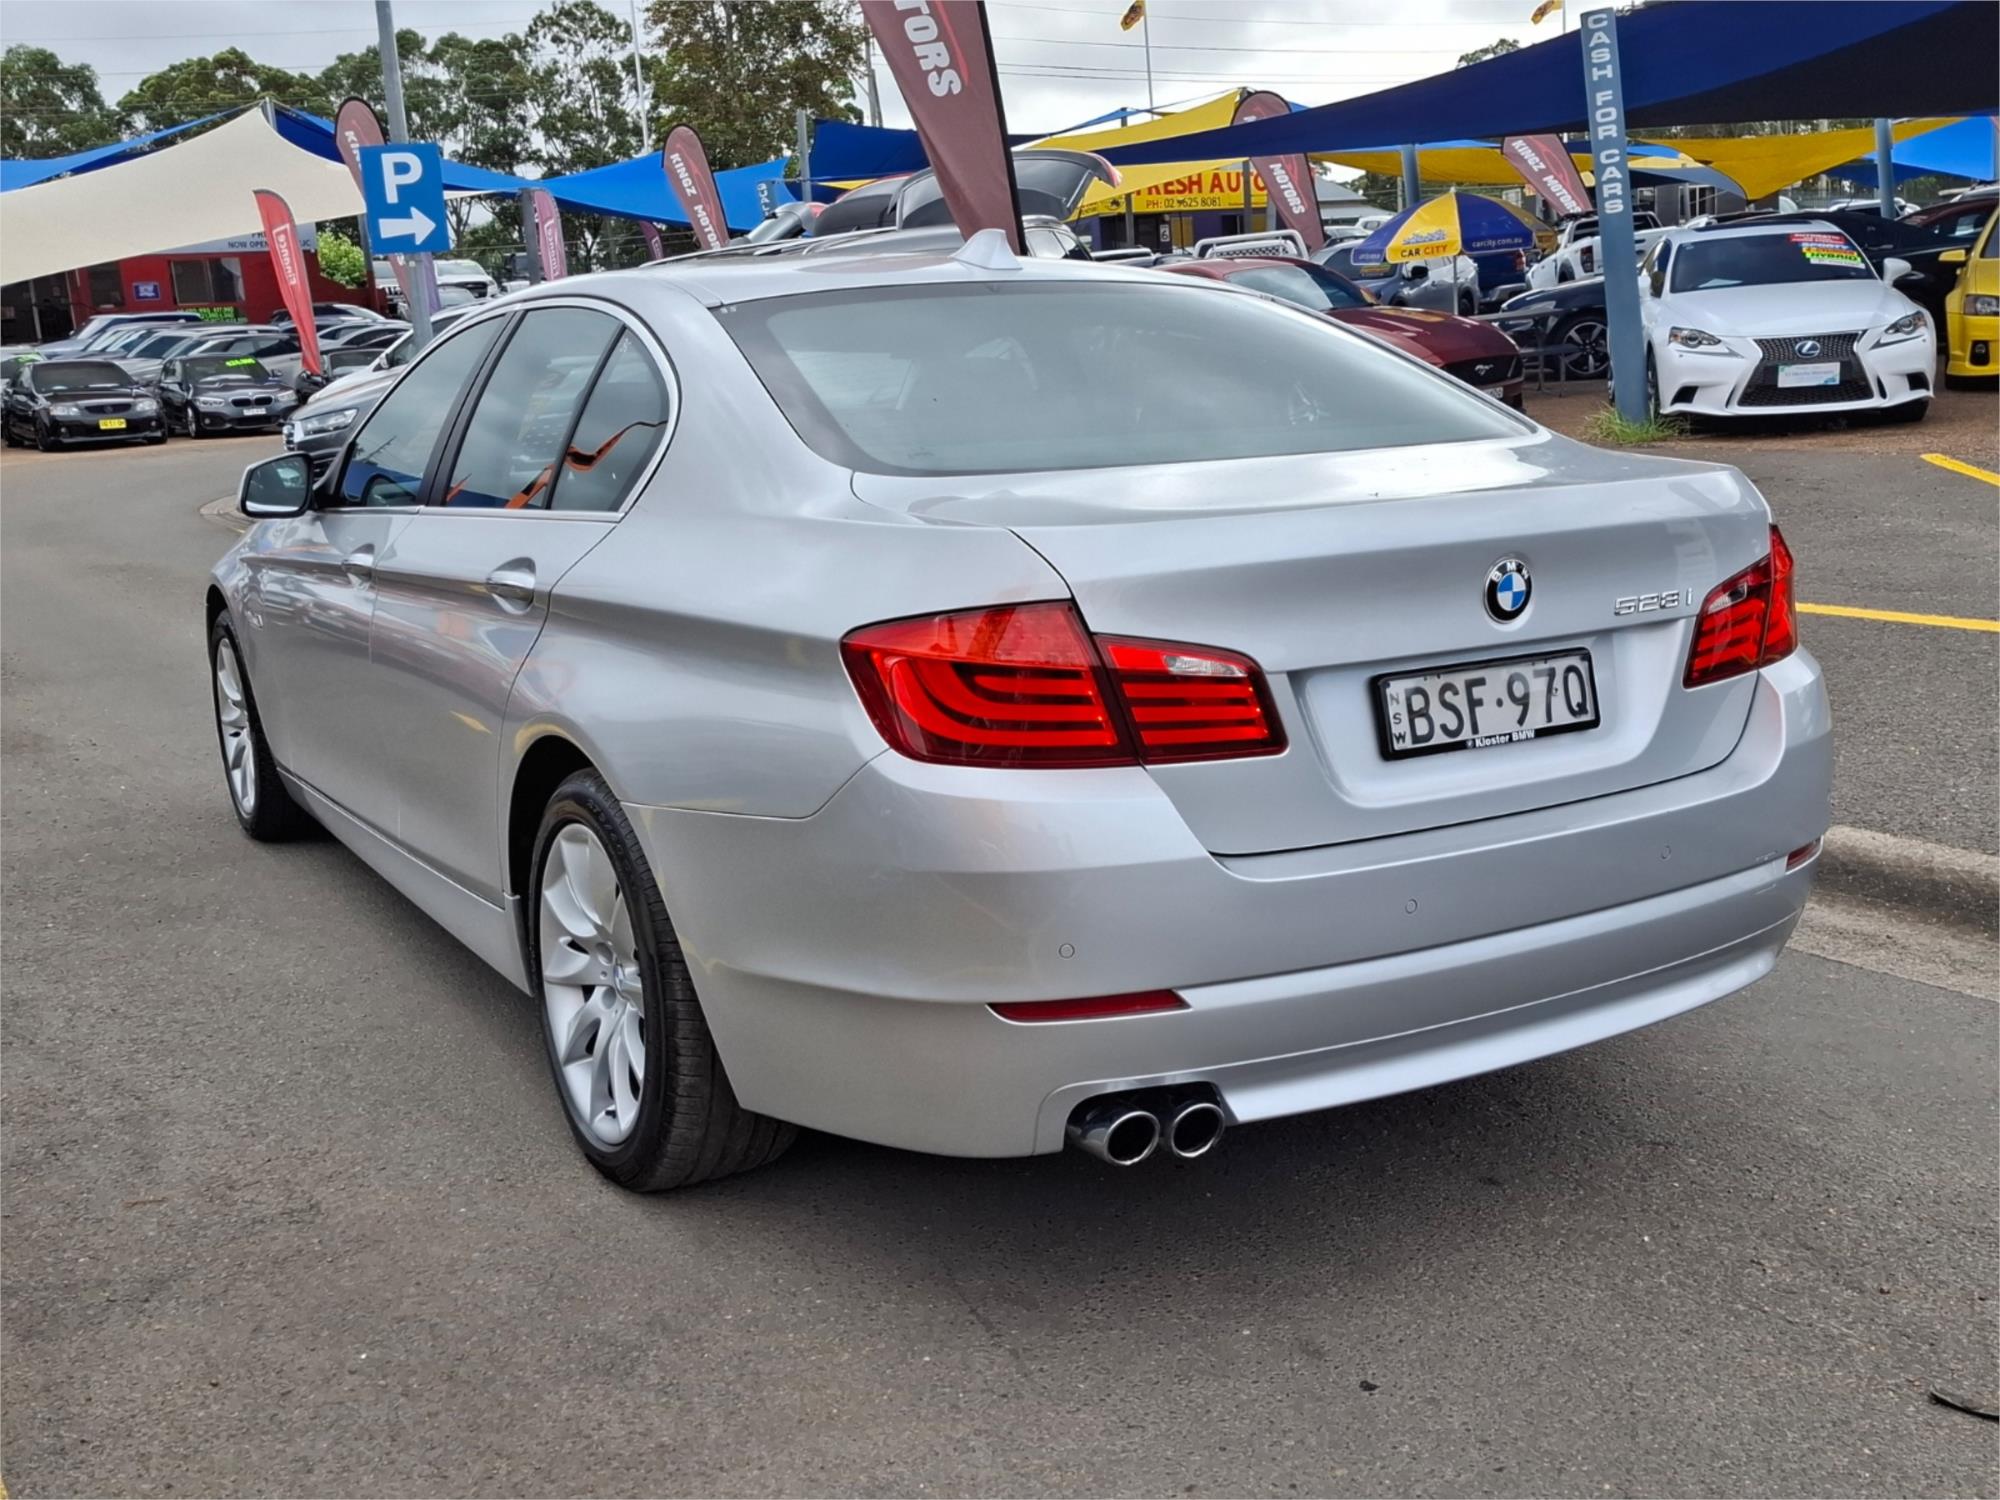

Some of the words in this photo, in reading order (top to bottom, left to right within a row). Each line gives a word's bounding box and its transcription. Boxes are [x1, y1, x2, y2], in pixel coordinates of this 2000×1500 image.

[1587, 13, 1613, 81] CASH
[1595, 90, 1617, 140] FOR
[1512, 139, 1546, 172] KINGZ
[381, 152, 422, 203] P
[670, 153, 697, 197] KINGZ
[1269, 163, 1305, 214] MOTORS
[1600, 149, 1624, 214] CARS
[1146, 200, 1162, 208] PH:
[1164, 198, 1175, 208] 02
[1200, 196, 1221, 207] 8081
[228, 241, 247, 249] NOW
[1400, 249, 1420, 258] CAR
[1424, 244, 1449, 255] CITY
[1471, 237, 1523, 248] carcity.com.au
[1492, 561, 1530, 582] BMW
[1475, 733, 1510, 748] Kloster
[1512, 729, 1535, 741] BMW
